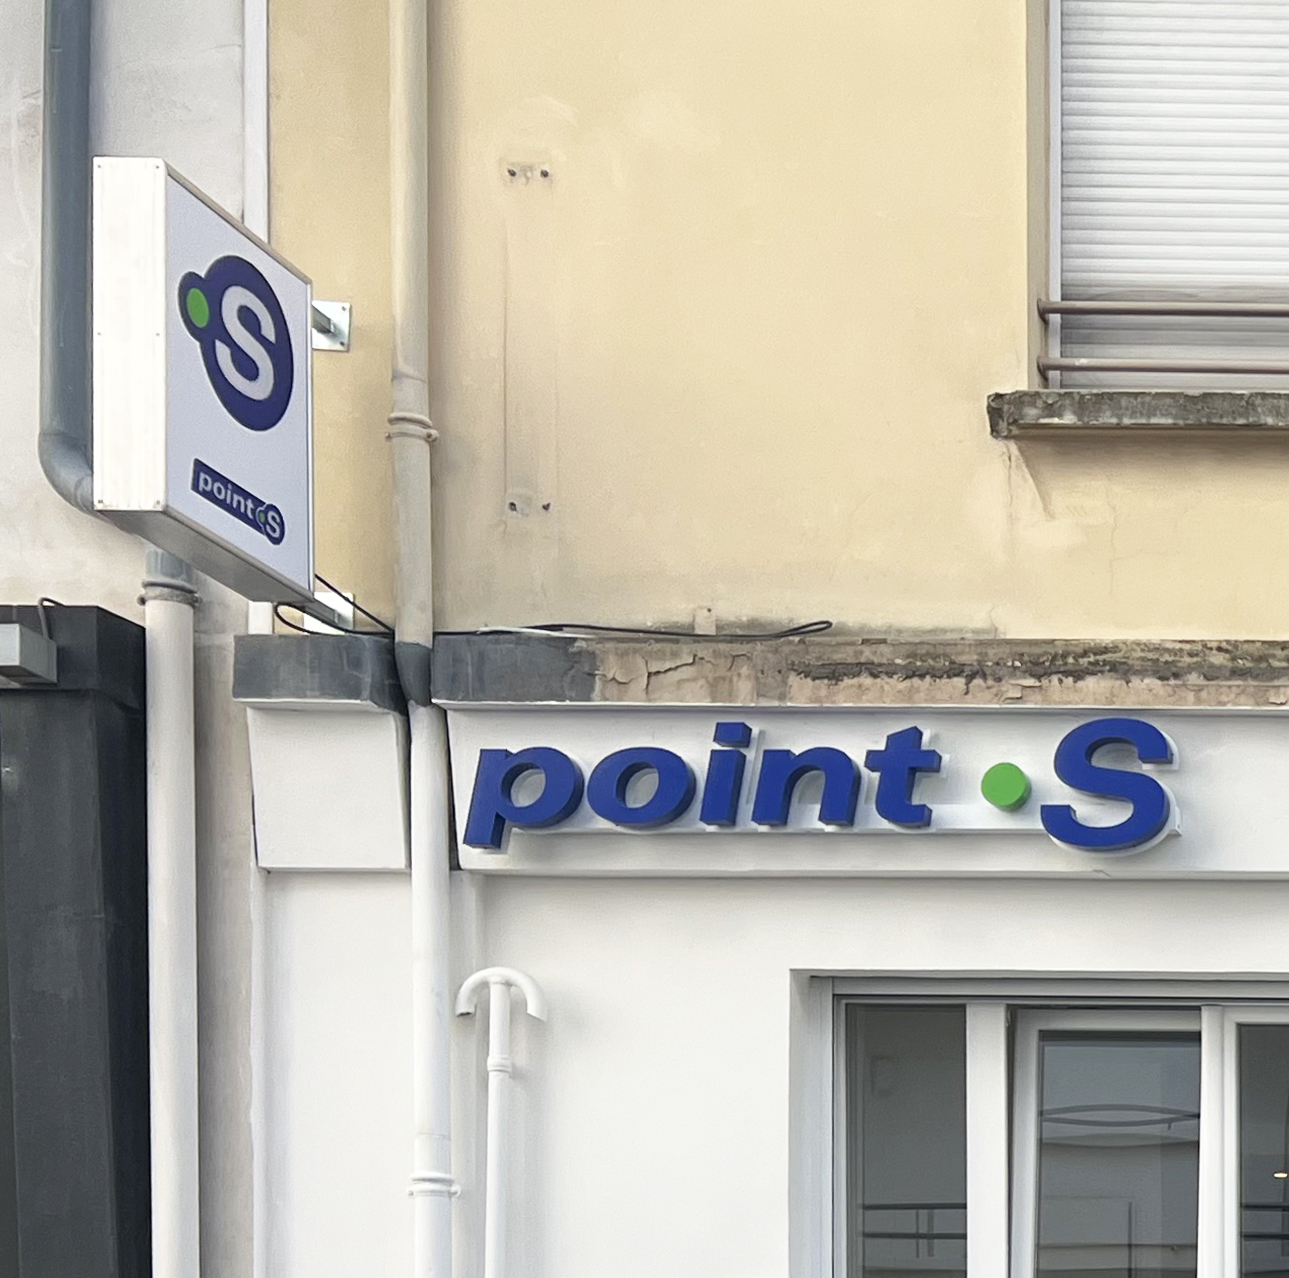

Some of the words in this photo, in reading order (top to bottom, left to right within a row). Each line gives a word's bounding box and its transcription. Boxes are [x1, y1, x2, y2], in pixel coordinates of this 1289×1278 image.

[214, 285, 277, 401] S
[198, 471, 255, 521] point
[265, 510, 281, 539] S
[462, 721, 942, 850] point
[1040, 717, 1175, 851] S
